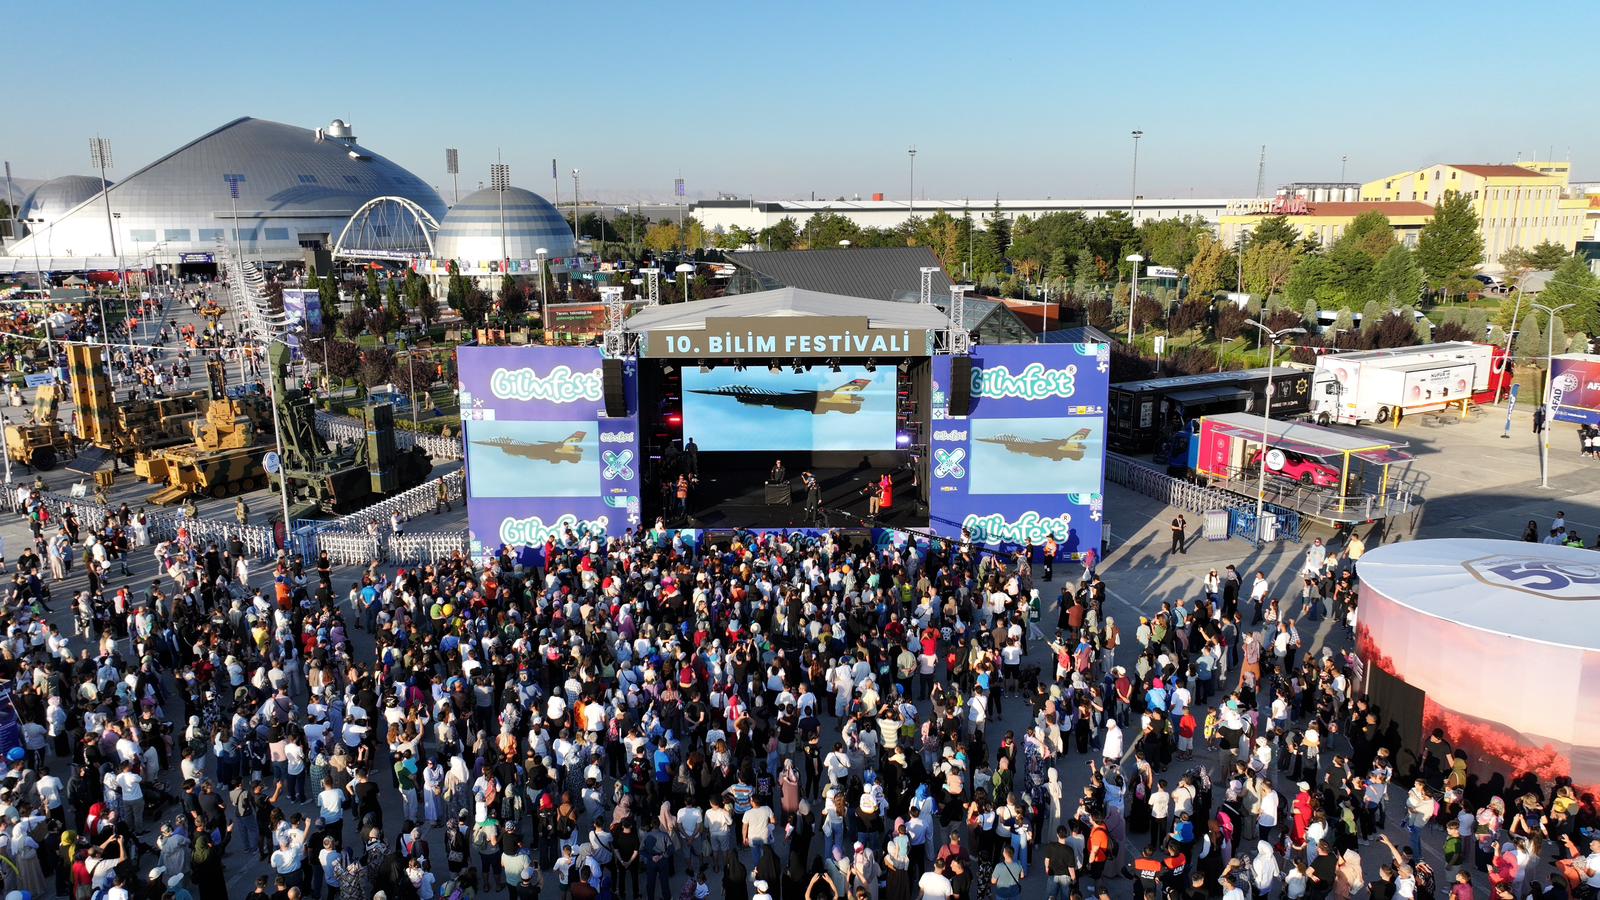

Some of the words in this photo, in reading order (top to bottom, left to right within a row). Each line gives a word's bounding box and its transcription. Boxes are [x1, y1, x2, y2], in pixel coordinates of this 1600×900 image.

[665, 335, 700, 353] 10.
[708, 331, 776, 353] BİLİM
[785, 330, 909, 352] FESTİVALİ
[1551, 388, 1562, 411] AFAD
